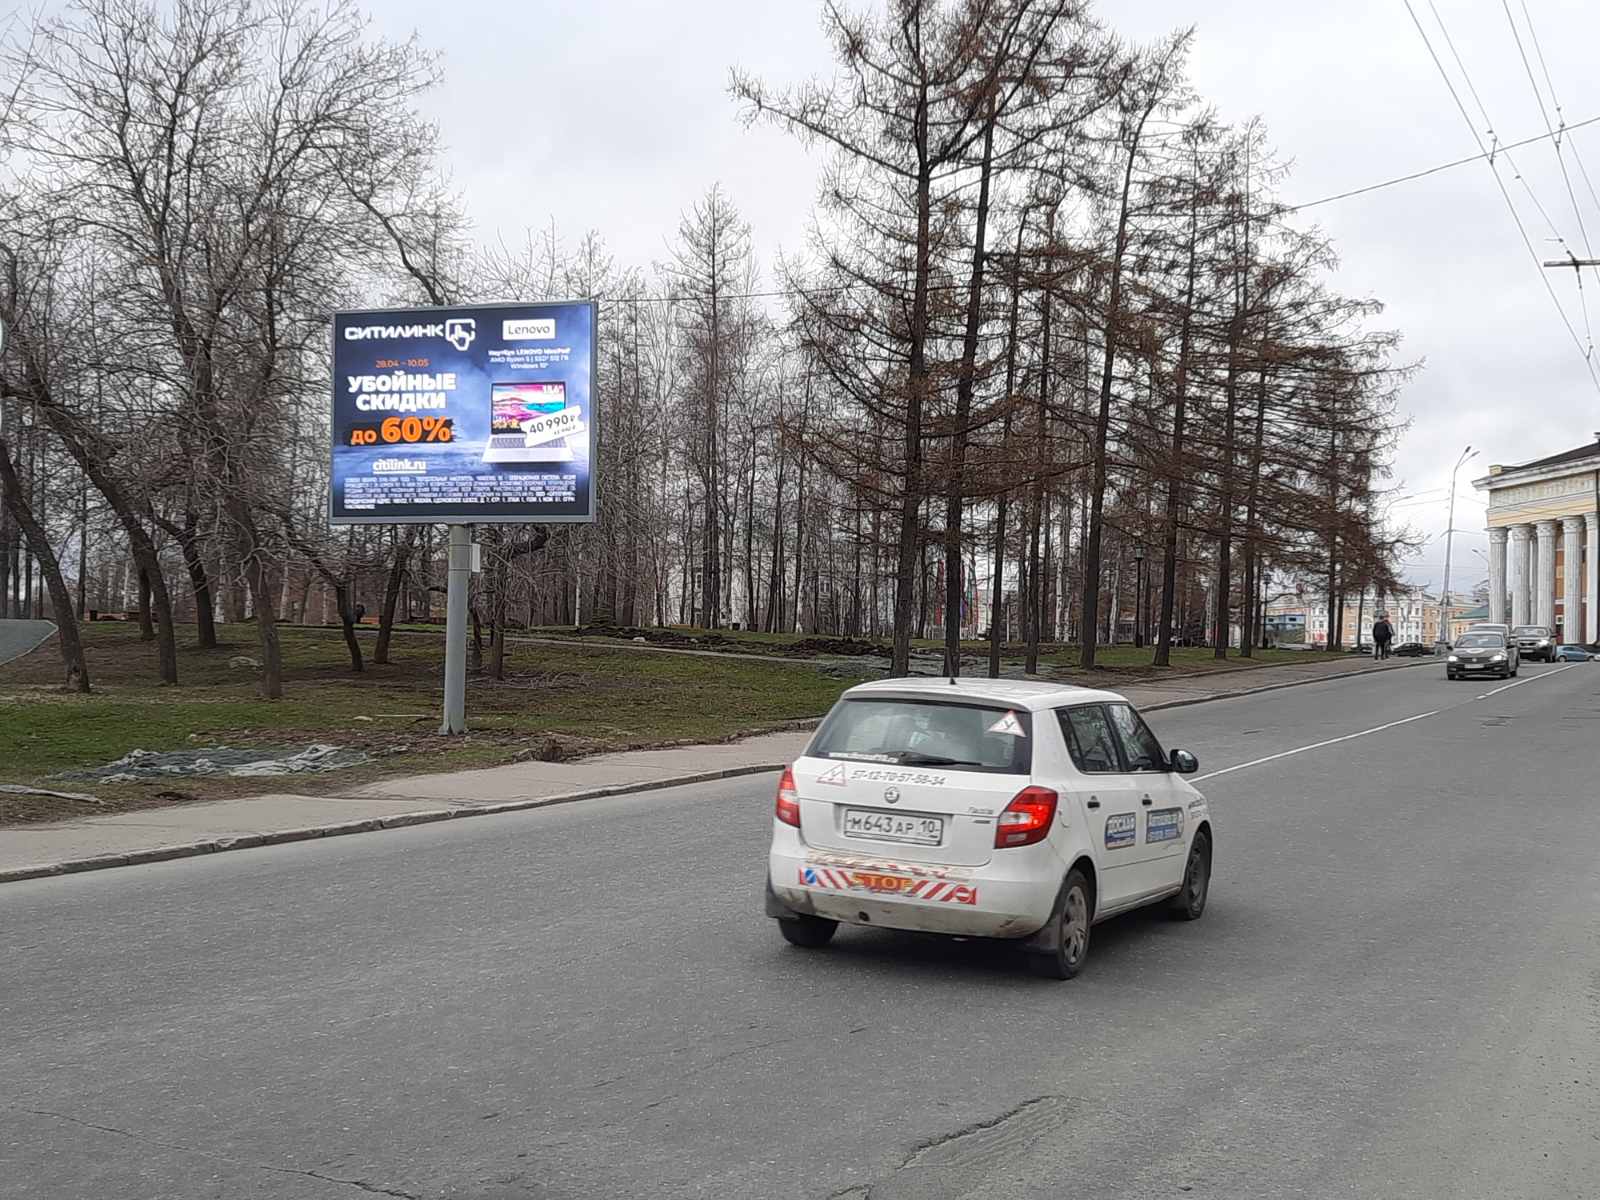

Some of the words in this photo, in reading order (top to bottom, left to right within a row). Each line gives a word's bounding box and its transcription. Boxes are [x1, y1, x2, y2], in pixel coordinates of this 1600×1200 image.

[344, 324, 444, 340] СИТИЛИНК
[508, 325, 550, 335] Lenovo
[348, 371, 456, 393] УБОЙНЫЕ
[356, 392, 446, 412] СКИДКИ
[382, 416, 451, 443] 60%
